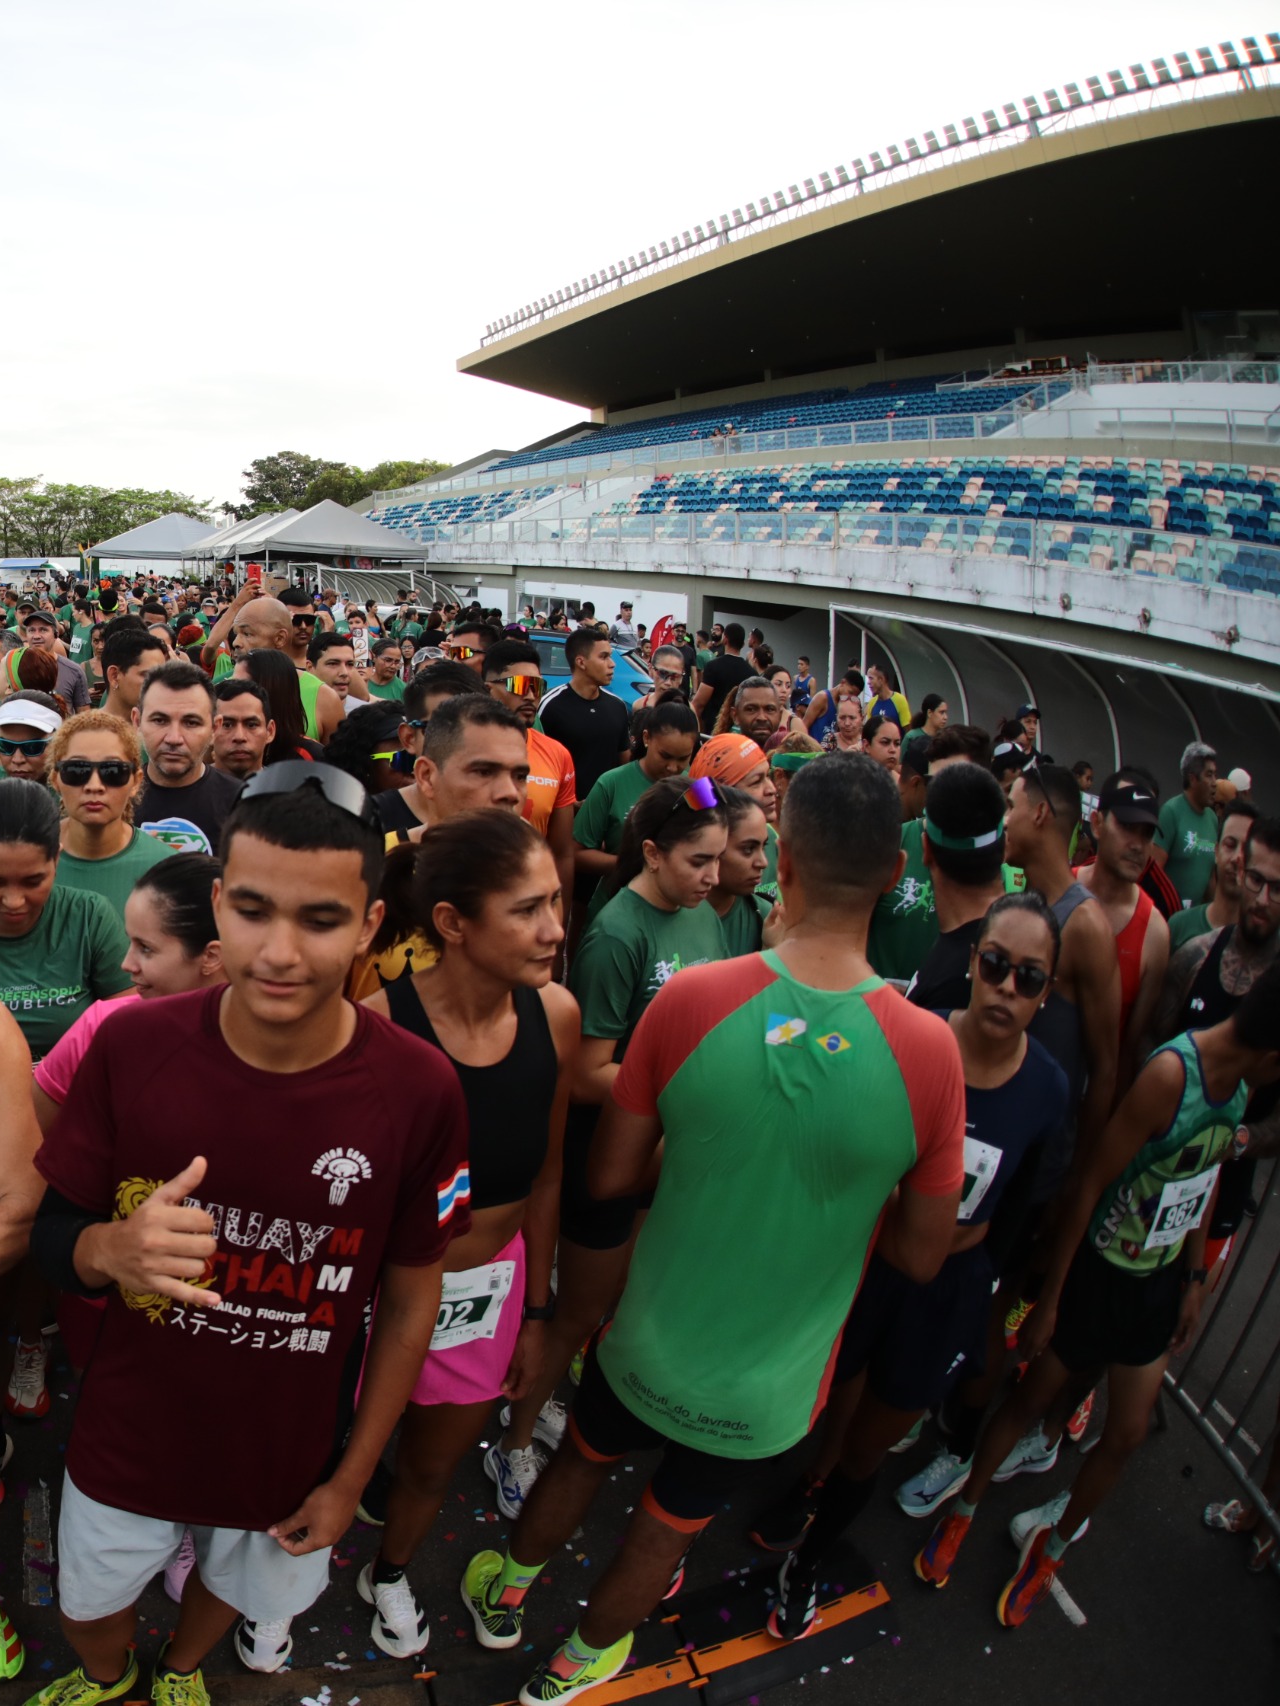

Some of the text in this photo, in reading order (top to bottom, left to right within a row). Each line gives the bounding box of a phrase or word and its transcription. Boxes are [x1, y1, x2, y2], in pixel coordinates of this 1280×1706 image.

[1163, 1198, 1198, 1230] 962
[170, 1306, 331, 1353] ステーション戦闘
[256, 1308, 307, 1324] FIGHTER
[628, 1372, 749, 1431] @jabuti_do_lavrado
[681, 1421, 705, 1433] jabuti
[707, 1428, 718, 1436] do
[720, 1431, 754, 1441] lavrado
